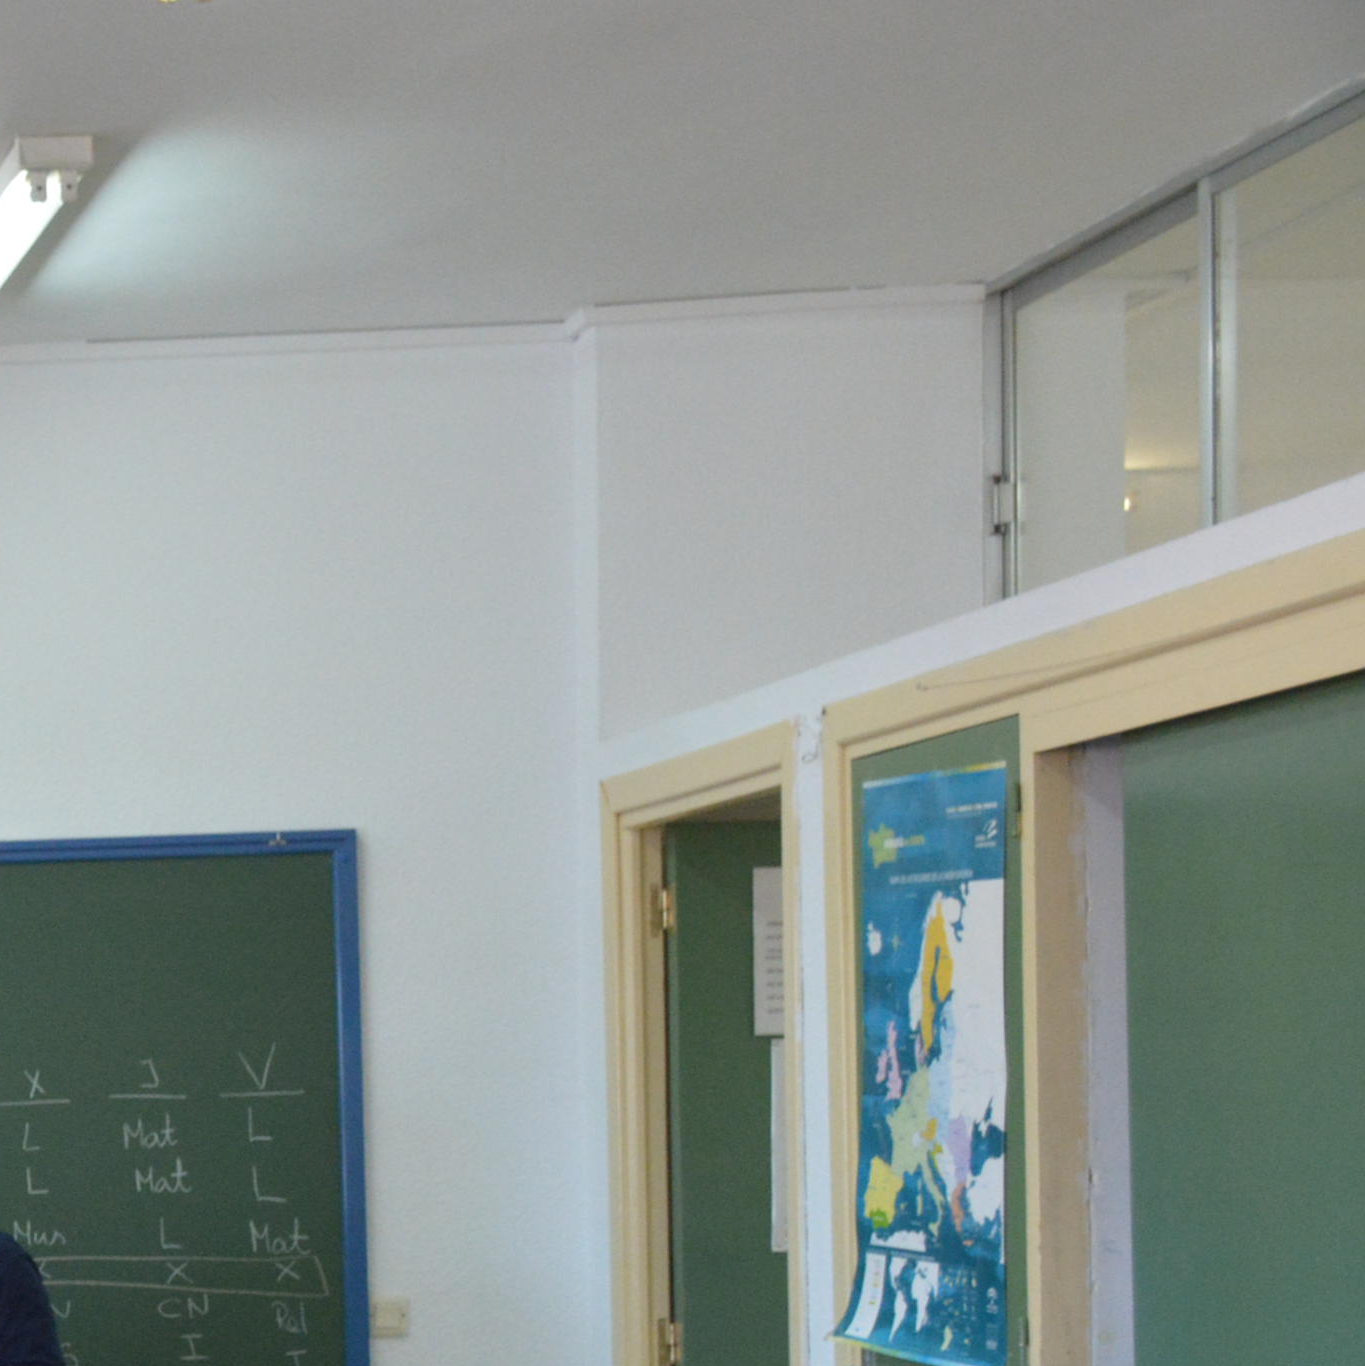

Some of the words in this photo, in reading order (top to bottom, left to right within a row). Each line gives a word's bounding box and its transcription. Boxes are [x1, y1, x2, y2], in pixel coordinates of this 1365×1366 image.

[237, 1042, 277, 1091] V
[22, 1121, 41, 1151] L
[122, 1111, 178, 1150] Mat
[247, 1105, 273, 1143] L
[26, 1166, 49, 1195] L
[135, 1155, 192, 1193] Mat
[252, 1165, 287, 1203] L
[159, 1216, 182, 1249] L
[249, 1216, 311, 1255] Mat
